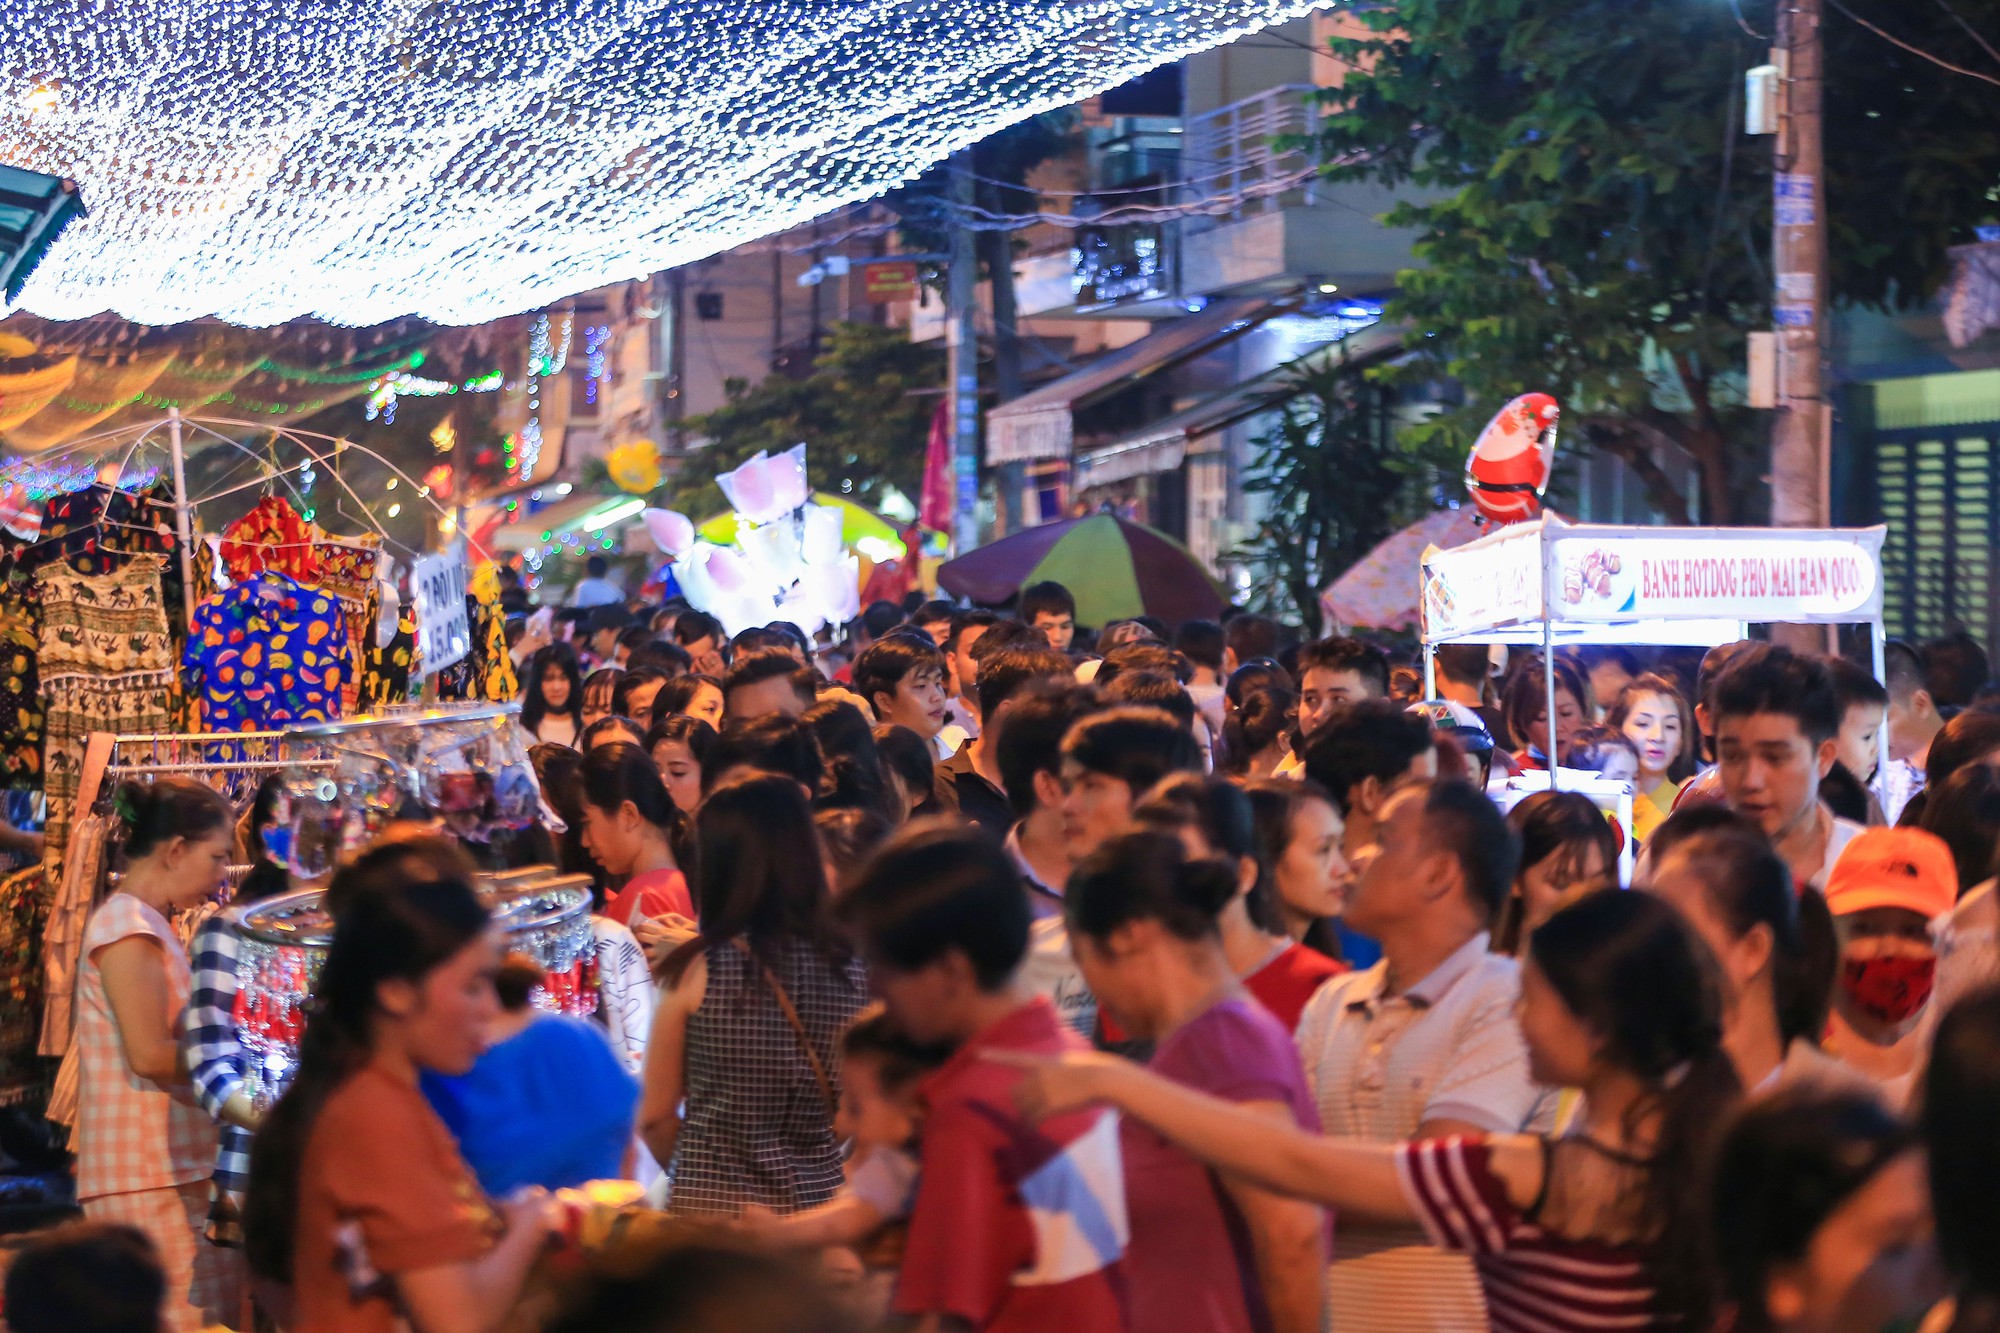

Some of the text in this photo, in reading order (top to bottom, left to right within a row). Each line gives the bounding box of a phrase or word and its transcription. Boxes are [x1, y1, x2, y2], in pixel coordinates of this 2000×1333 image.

[1642, 559, 1680, 599] BANH
[1684, 558, 1737, 598] HOTDOG
[1741, 557, 1768, 598] PHO
[1771, 557, 1796, 597] MAI
[1799, 556, 1828, 597] HAN
